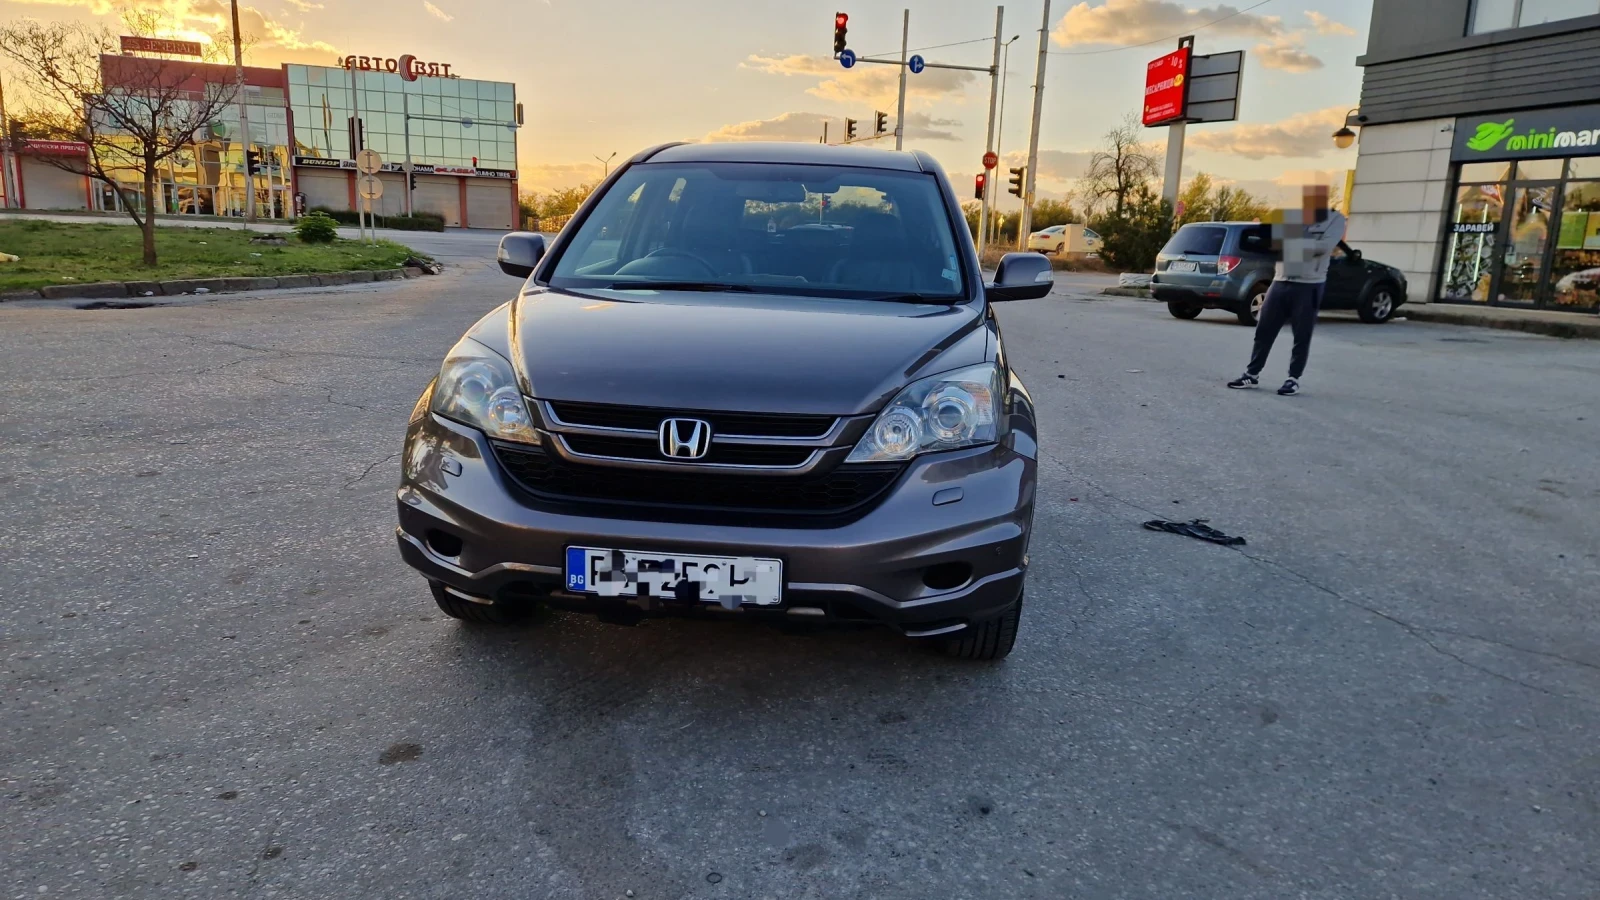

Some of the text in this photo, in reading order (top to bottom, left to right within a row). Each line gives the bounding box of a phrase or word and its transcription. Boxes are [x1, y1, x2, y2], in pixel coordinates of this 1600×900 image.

[143, 40, 197, 53] GENERALI
[302, 158, 340, 166] DUNLOP
[985, 156, 996, 164] STOP
[1453, 222, 1494, 232] ЗДРАВЕЙ
[570, 574, 584, 585] BG
